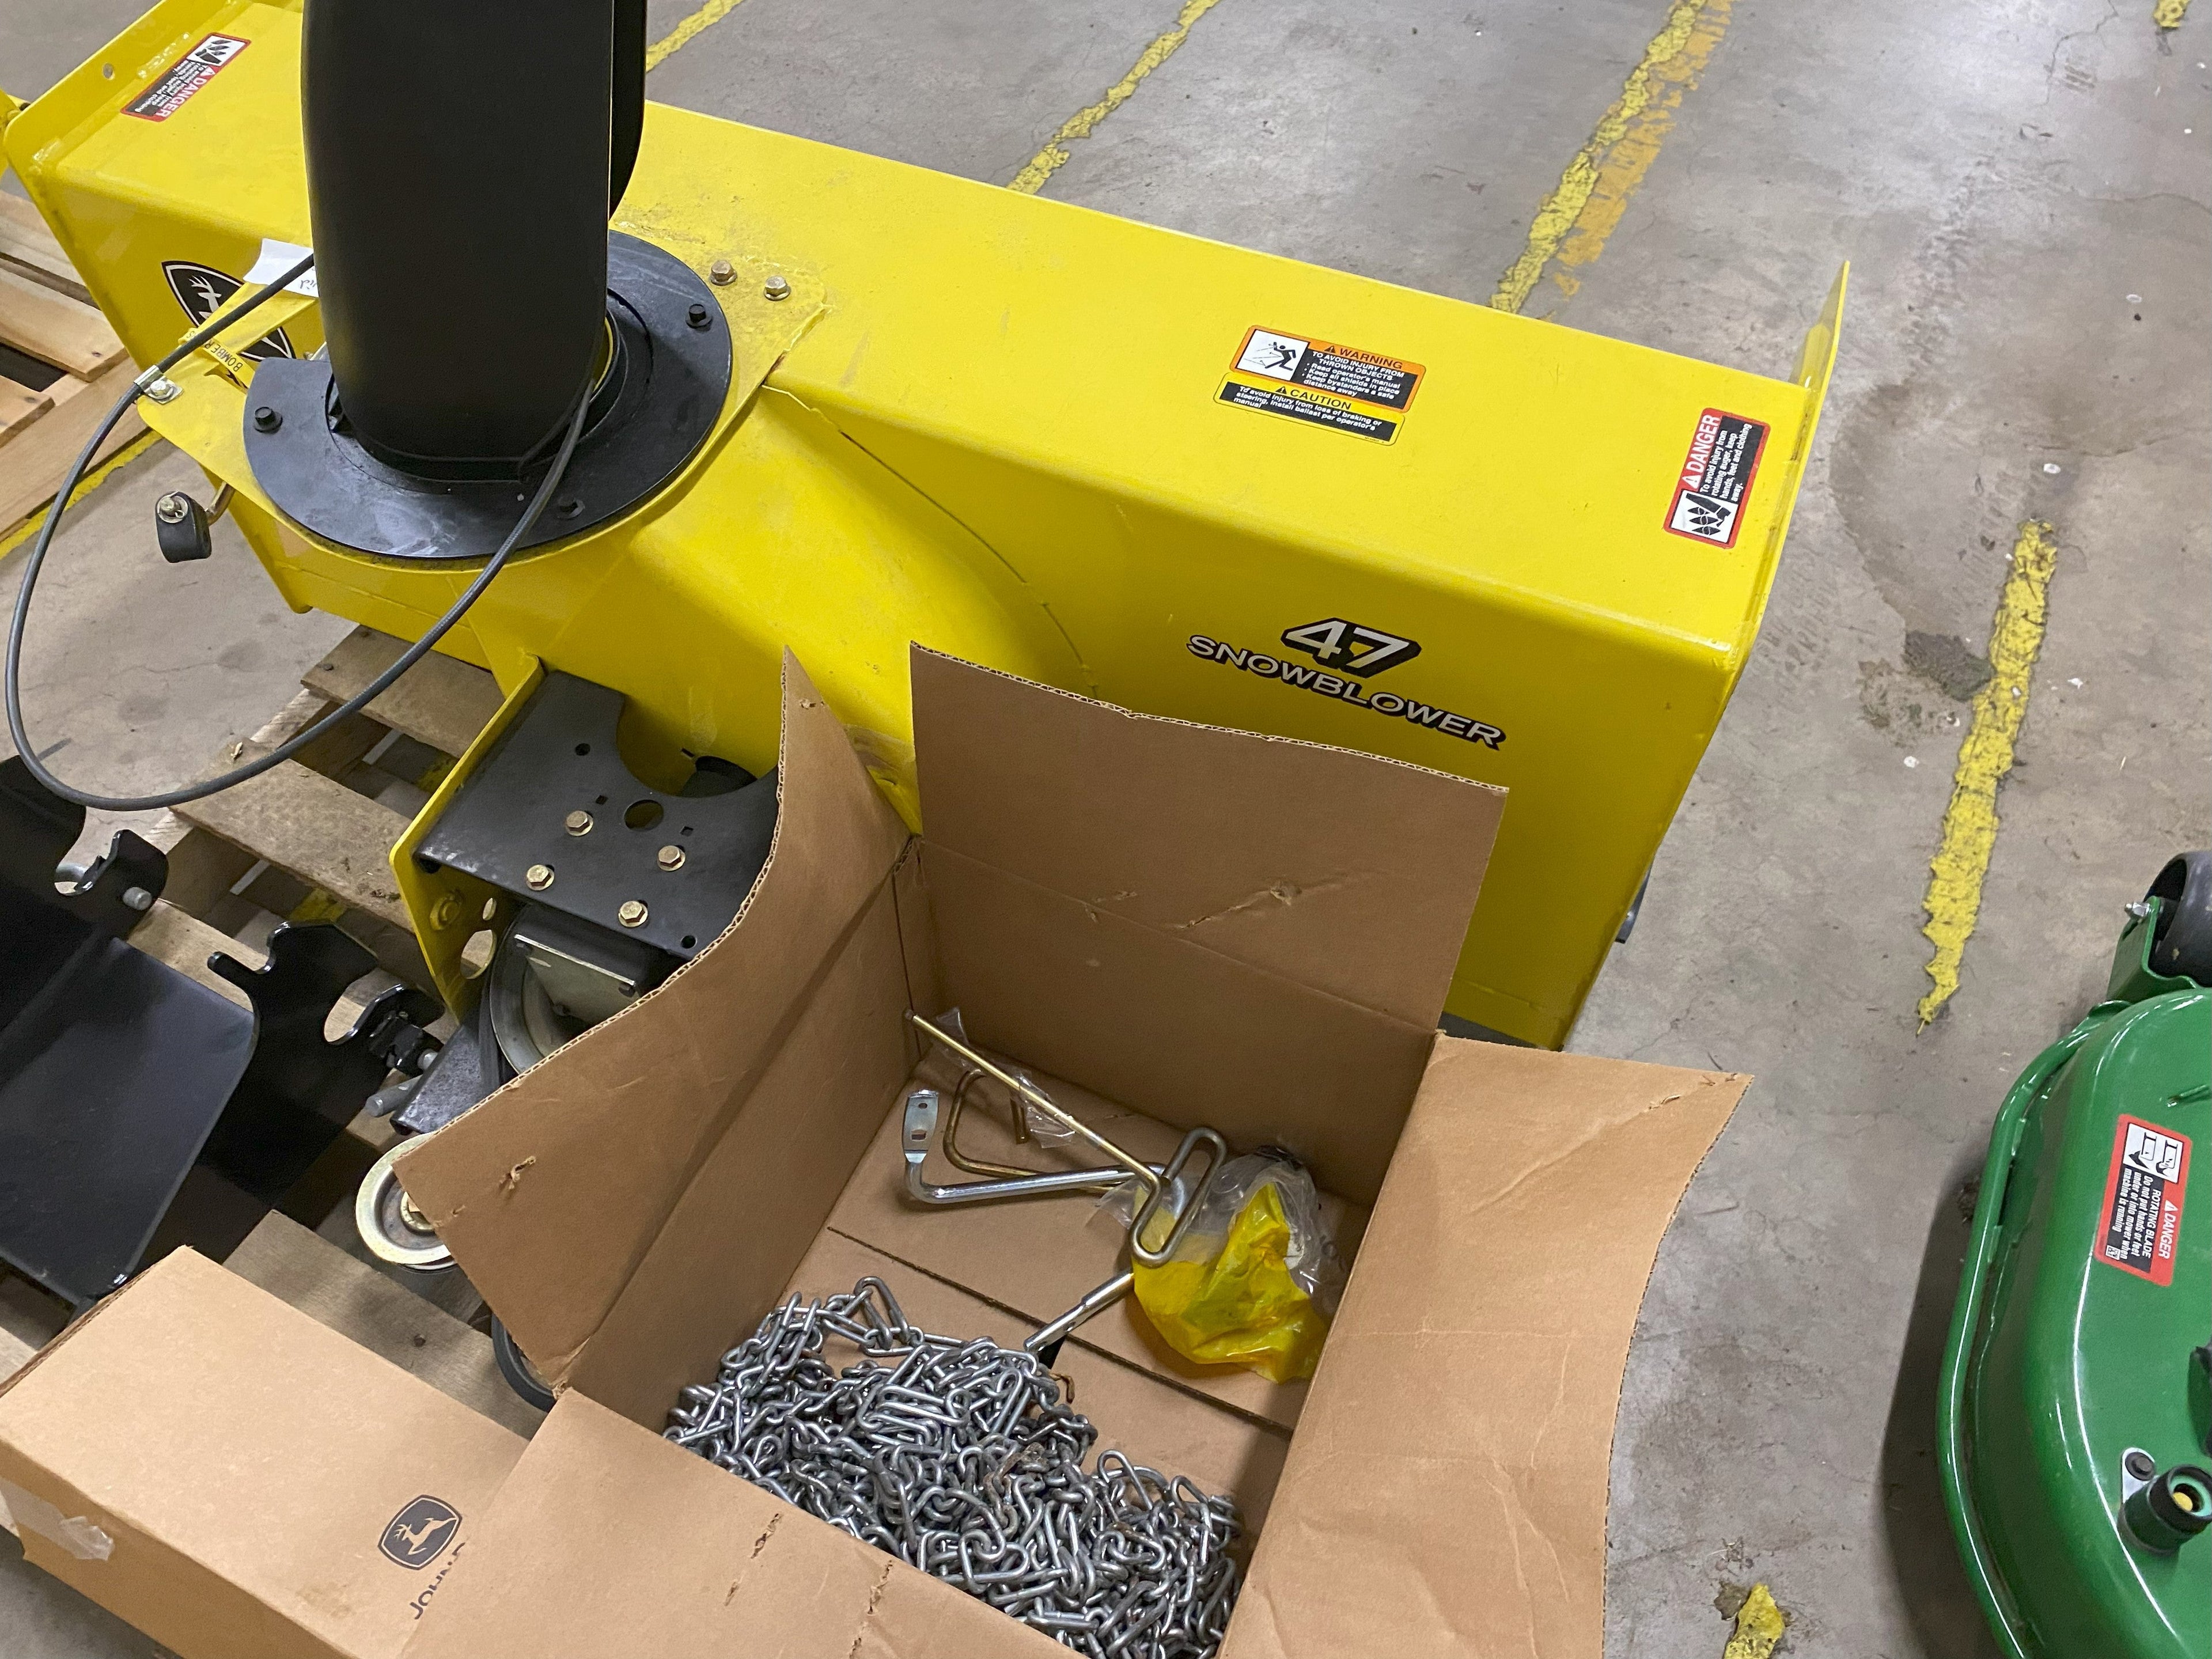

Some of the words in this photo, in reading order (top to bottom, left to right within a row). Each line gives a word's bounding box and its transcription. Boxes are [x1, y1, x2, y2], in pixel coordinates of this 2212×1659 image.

[156, 77, 207, 117] DANGER
[1324, 354, 1349, 364] AVOID
[1350, 361, 1379, 373] INJURY
[1380, 368, 1404, 378] FROM
[1339, 348, 1403, 369] WARNING
[1311, 363, 1331, 372] Read
[1332, 369, 1370, 382] operator's
[1372, 378, 1400, 389] manual
[1319, 358, 1354, 371] THROWN
[1356, 368, 1393, 381] OBJECTS
[1304, 379, 1336, 391] distance
[1337, 388, 1358, 397] away
[1306, 373, 1326, 382] Keep
[1327, 378, 1370, 393] bystanders
[1308, 368, 1328, 377] Keep
[1340, 374, 1368, 387] shields
[1378, 386, 1400, 395] place
[1249, 389, 1271, 399] avoid
[1272, 394, 1294, 405] injury
[1295, 400, 1313, 409] from
[1315, 404, 1331, 414] loss
[1342, 412, 1372, 424] braking
[1270, 400, 1294, 410] install
[1294, 406, 1321, 417] ballast
[1290, 389, 1351, 410] CAUTION
[1689, 415, 1721, 474] DANGER
[1715, 430, 1728, 445] from
[1737, 423, 1752, 449] clothing
[1709, 446, 1724, 465] injury
[1711, 470, 1728, 497] rotating
[1725, 433, 1738, 449] keep
[1733, 449, 1743, 463] and
[1705, 464, 1716, 484] avoid
[1727, 463, 1738, 476] feet
[1699, 484, 1710, 493] To
[1283, 619, 1415, 673] 47
[1187, 635, 1504, 749] SNOWBLOWER
[2120, 1168, 2132, 1197] machine
[2132, 1172, 2142, 1192] under
[2143, 1175, 2153, 1186] Do
[2119, 1198, 2127, 1206] is
[2130, 1192, 2138, 1201] or
[2141, 1186, 2150, 1199] not
[2127, 1200, 2138, 1215] into
[2137, 1198, 2148, 1211] put
[2147, 1189, 2161, 1229] ROTATING
[2112, 1205, 2125, 1232] running
[2123, 1215, 2134, 1240] mower
[2135, 1210, 2147, 1232] hands
[2134, 1232, 2142, 1241] or
[2142, 1229, 2155, 1258] BLADE
[2158, 1213, 2176, 1259] DANGER
[2120, 1240, 2130, 1259] when
[2131, 1241, 2142, 1256] feet
